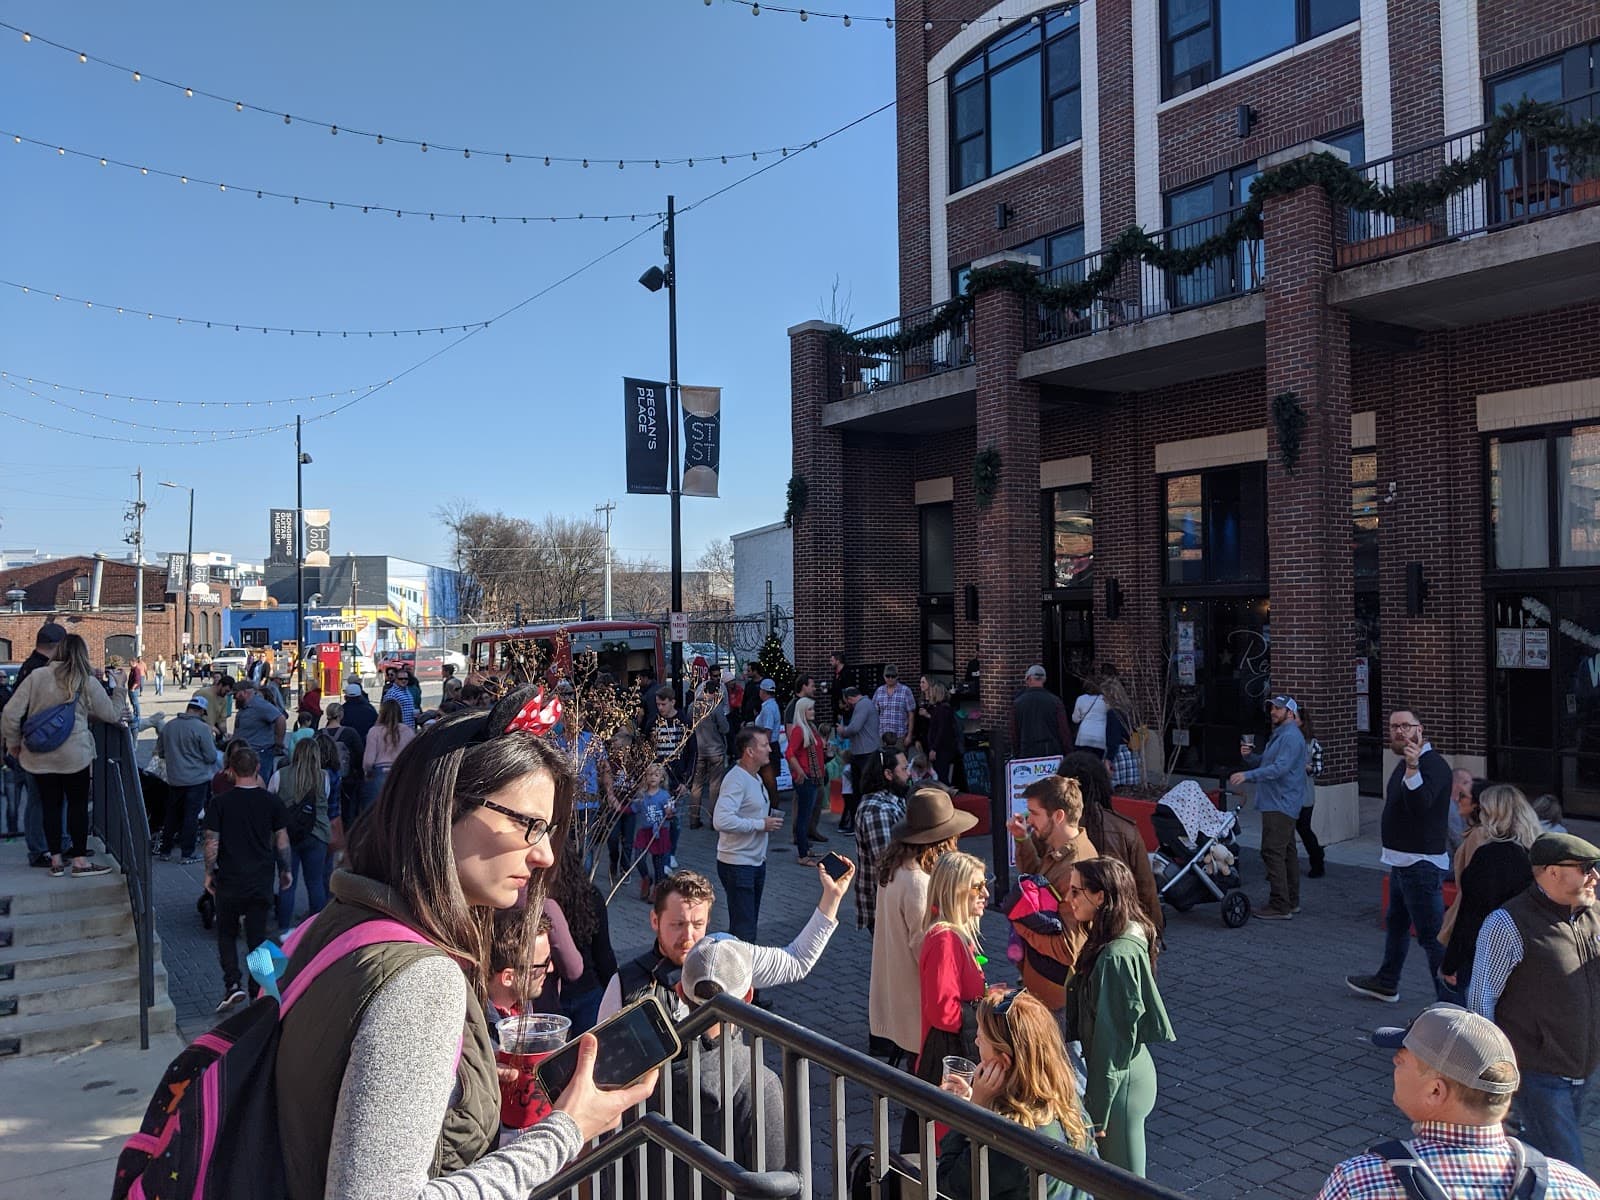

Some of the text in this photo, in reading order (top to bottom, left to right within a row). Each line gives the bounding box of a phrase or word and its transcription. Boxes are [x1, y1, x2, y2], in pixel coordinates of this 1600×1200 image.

[637, 386, 647, 433] PLACE
[646, 388, 656, 450] REGAN'S
[692, 422, 715, 441] ST
[692, 442, 715, 461] ST
[310, 528, 327, 538] ST
[310, 539, 327, 549] ST
